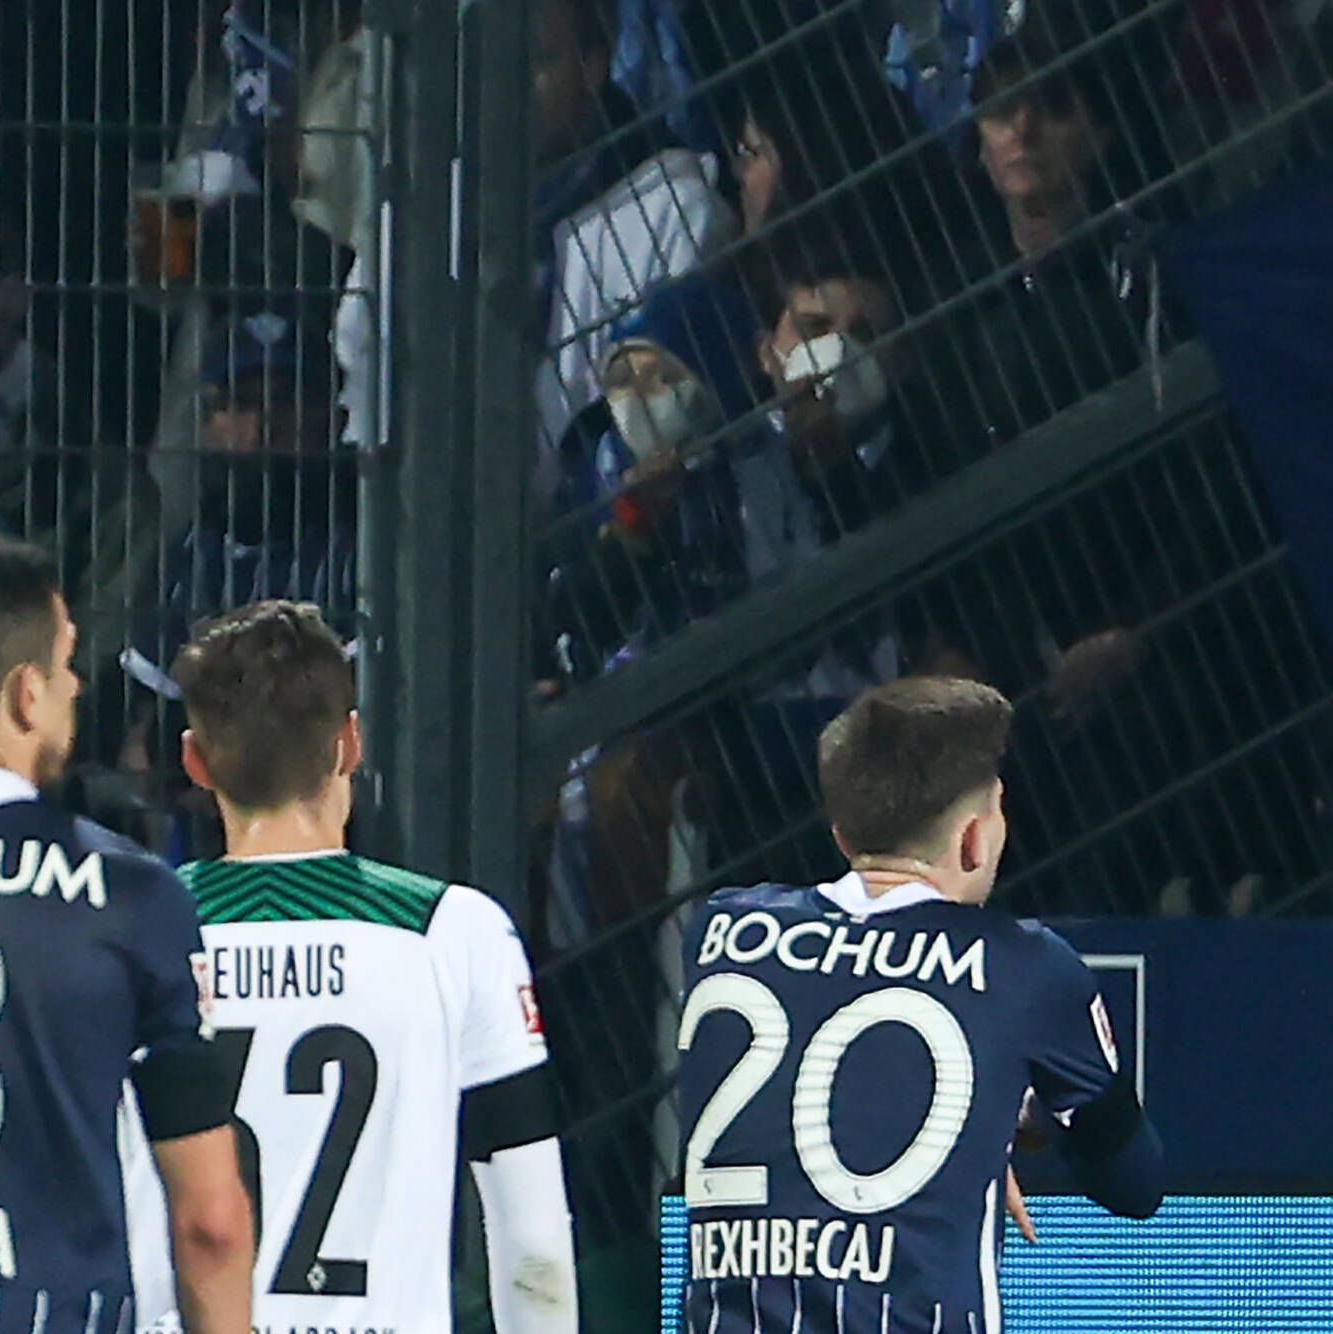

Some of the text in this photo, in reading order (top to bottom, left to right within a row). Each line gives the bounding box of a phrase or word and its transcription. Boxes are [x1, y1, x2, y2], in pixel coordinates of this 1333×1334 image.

[212, 944, 345, 999] EUHAUS
[698, 913, 985, 991] BOCHUM
[678, 971, 974, 1213] 20
[691, 1219, 894, 1282] REXHBECAJ
